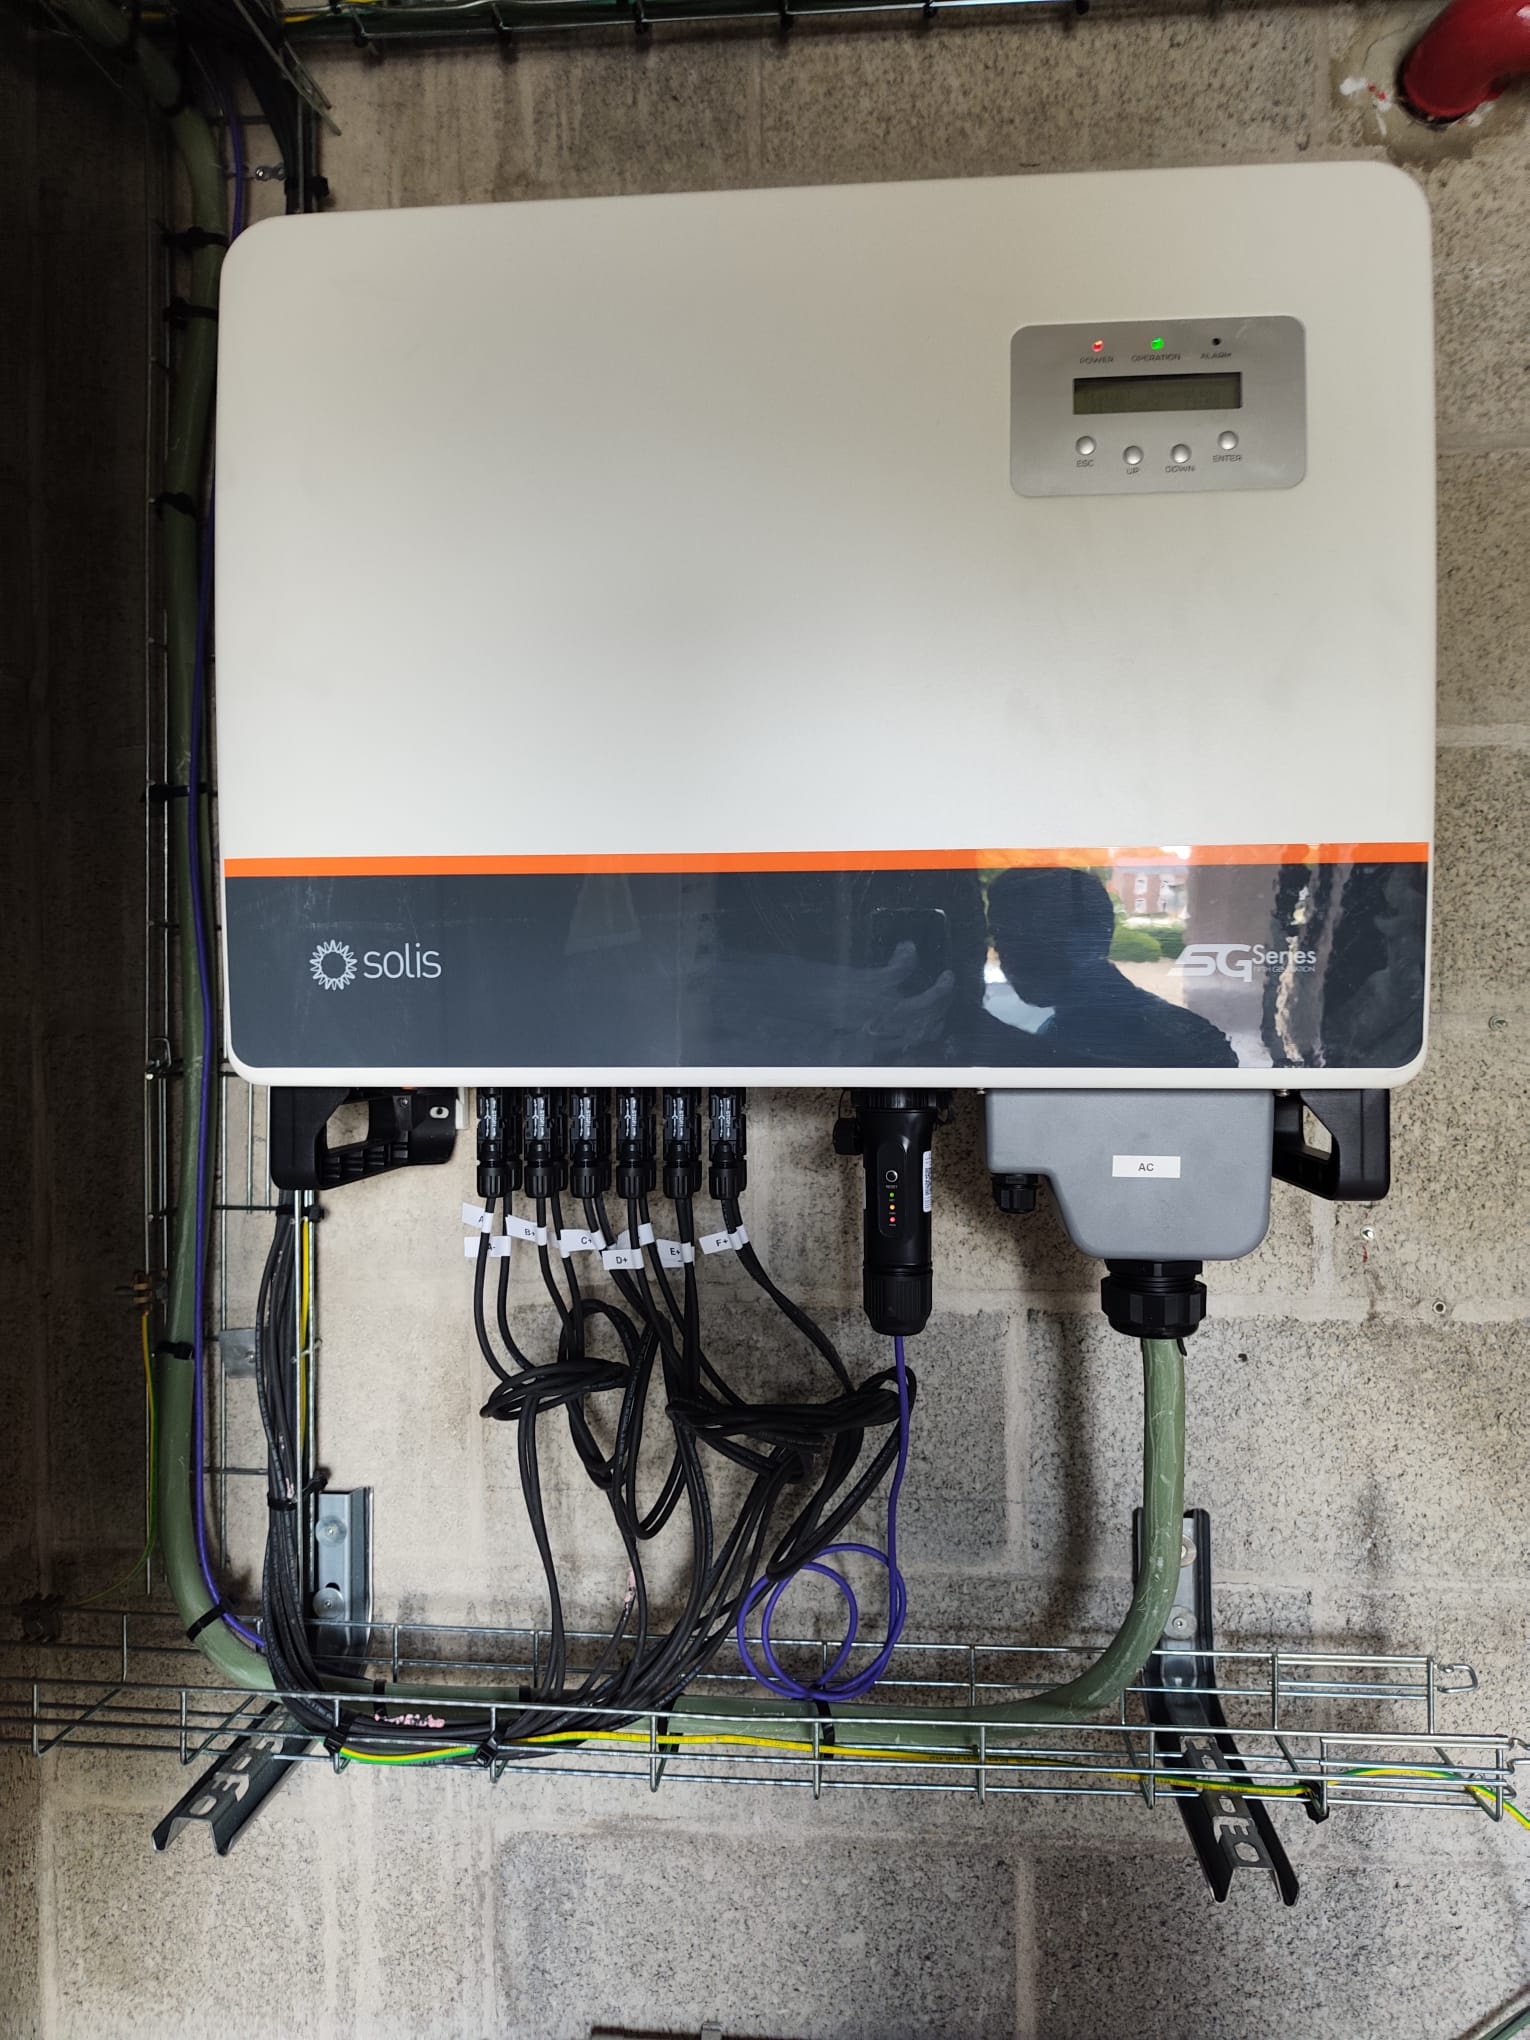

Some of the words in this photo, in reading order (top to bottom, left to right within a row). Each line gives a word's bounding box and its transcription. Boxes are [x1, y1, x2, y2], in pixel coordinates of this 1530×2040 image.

[1079, 355, 1114, 364] POWER
[1131, 353, 1181, 362] OPERATION
[1200, 351, 1232, 360] ALARM
[1076, 459, 1094, 467] ESC
[1212, 454, 1242, 463] ENTER
[1126, 467, 1140, 475] UP
[1165, 465, 1195, 473] DOWN
[363, 942, 442, 979] solis
[1138, 1162, 1155, 1172] AC
[524, 1228, 536, 1236] B+
[580, 1236, 592, 1245] C+
[715, 1238, 729, 1247] F+
[669, 1247, 681, 1256] E+
[615, 1256, 628, 1264] D+
